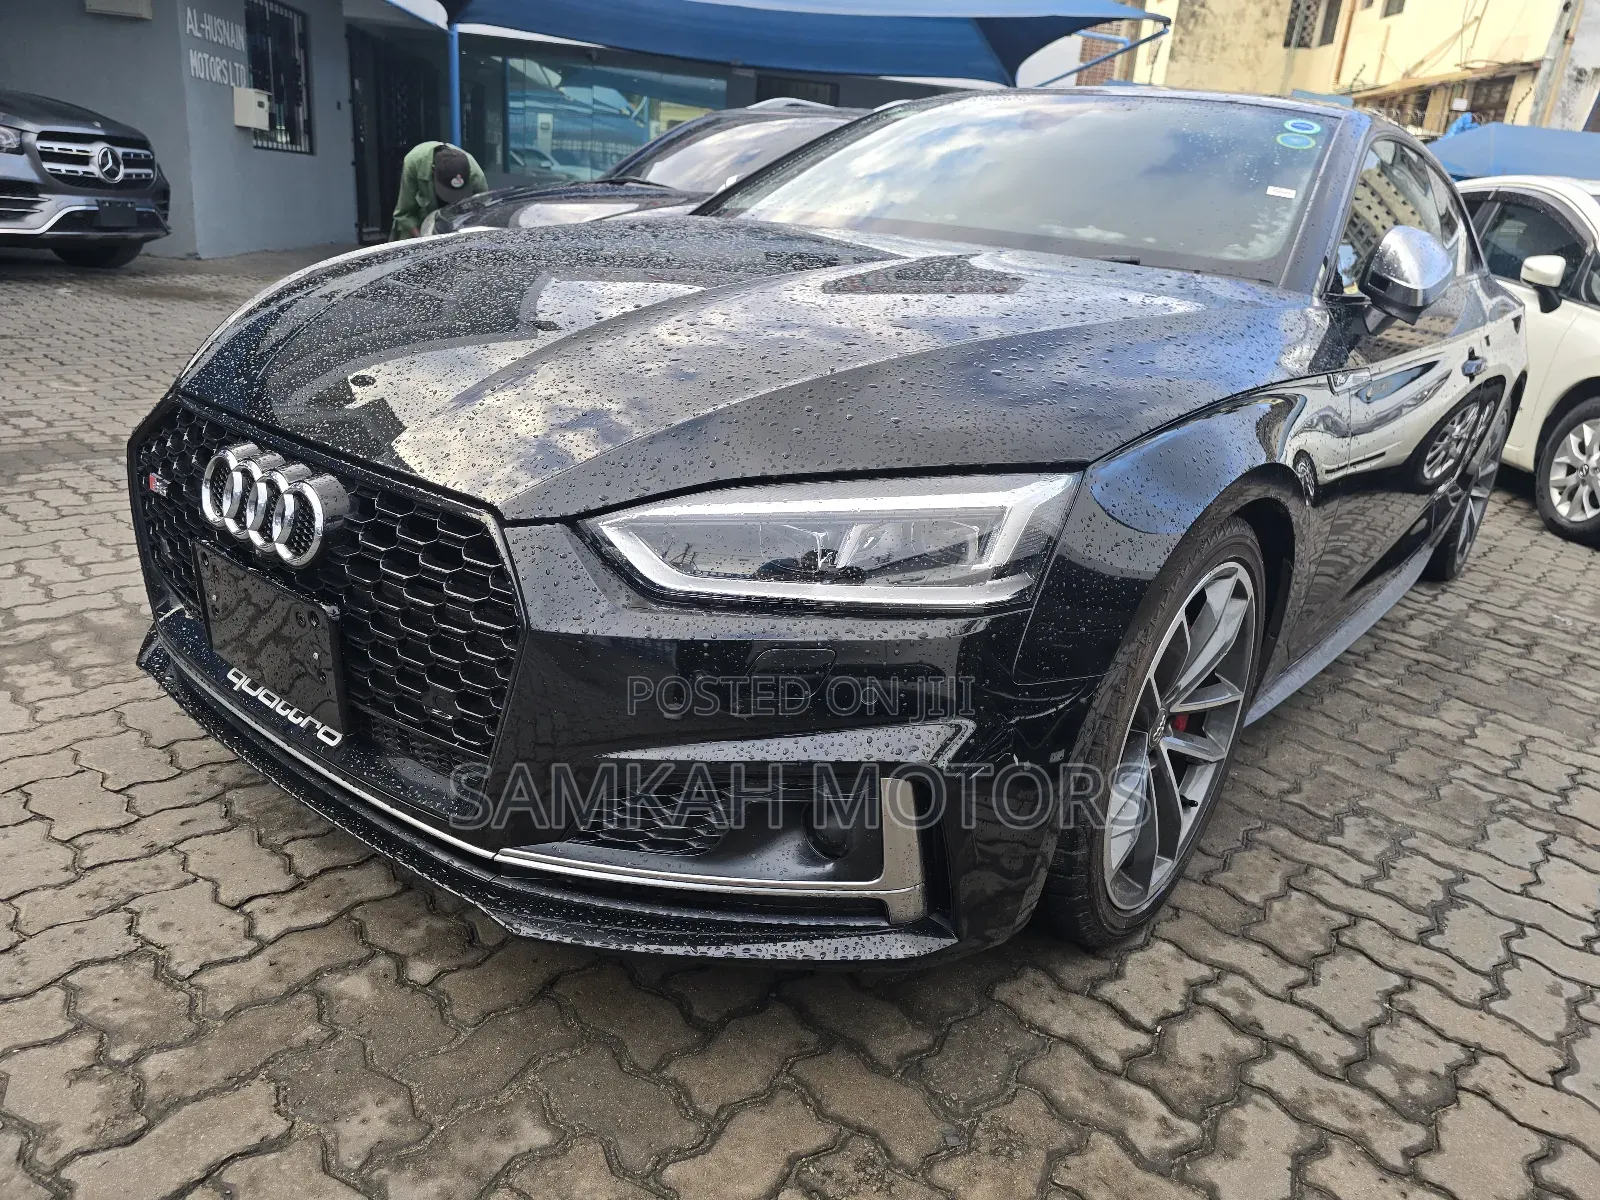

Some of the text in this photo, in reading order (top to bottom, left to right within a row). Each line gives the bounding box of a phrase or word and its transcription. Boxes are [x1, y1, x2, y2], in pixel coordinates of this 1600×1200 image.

[189, 49, 247, 88] MOTORS LTD
[226, 667, 343, 747] quattro
